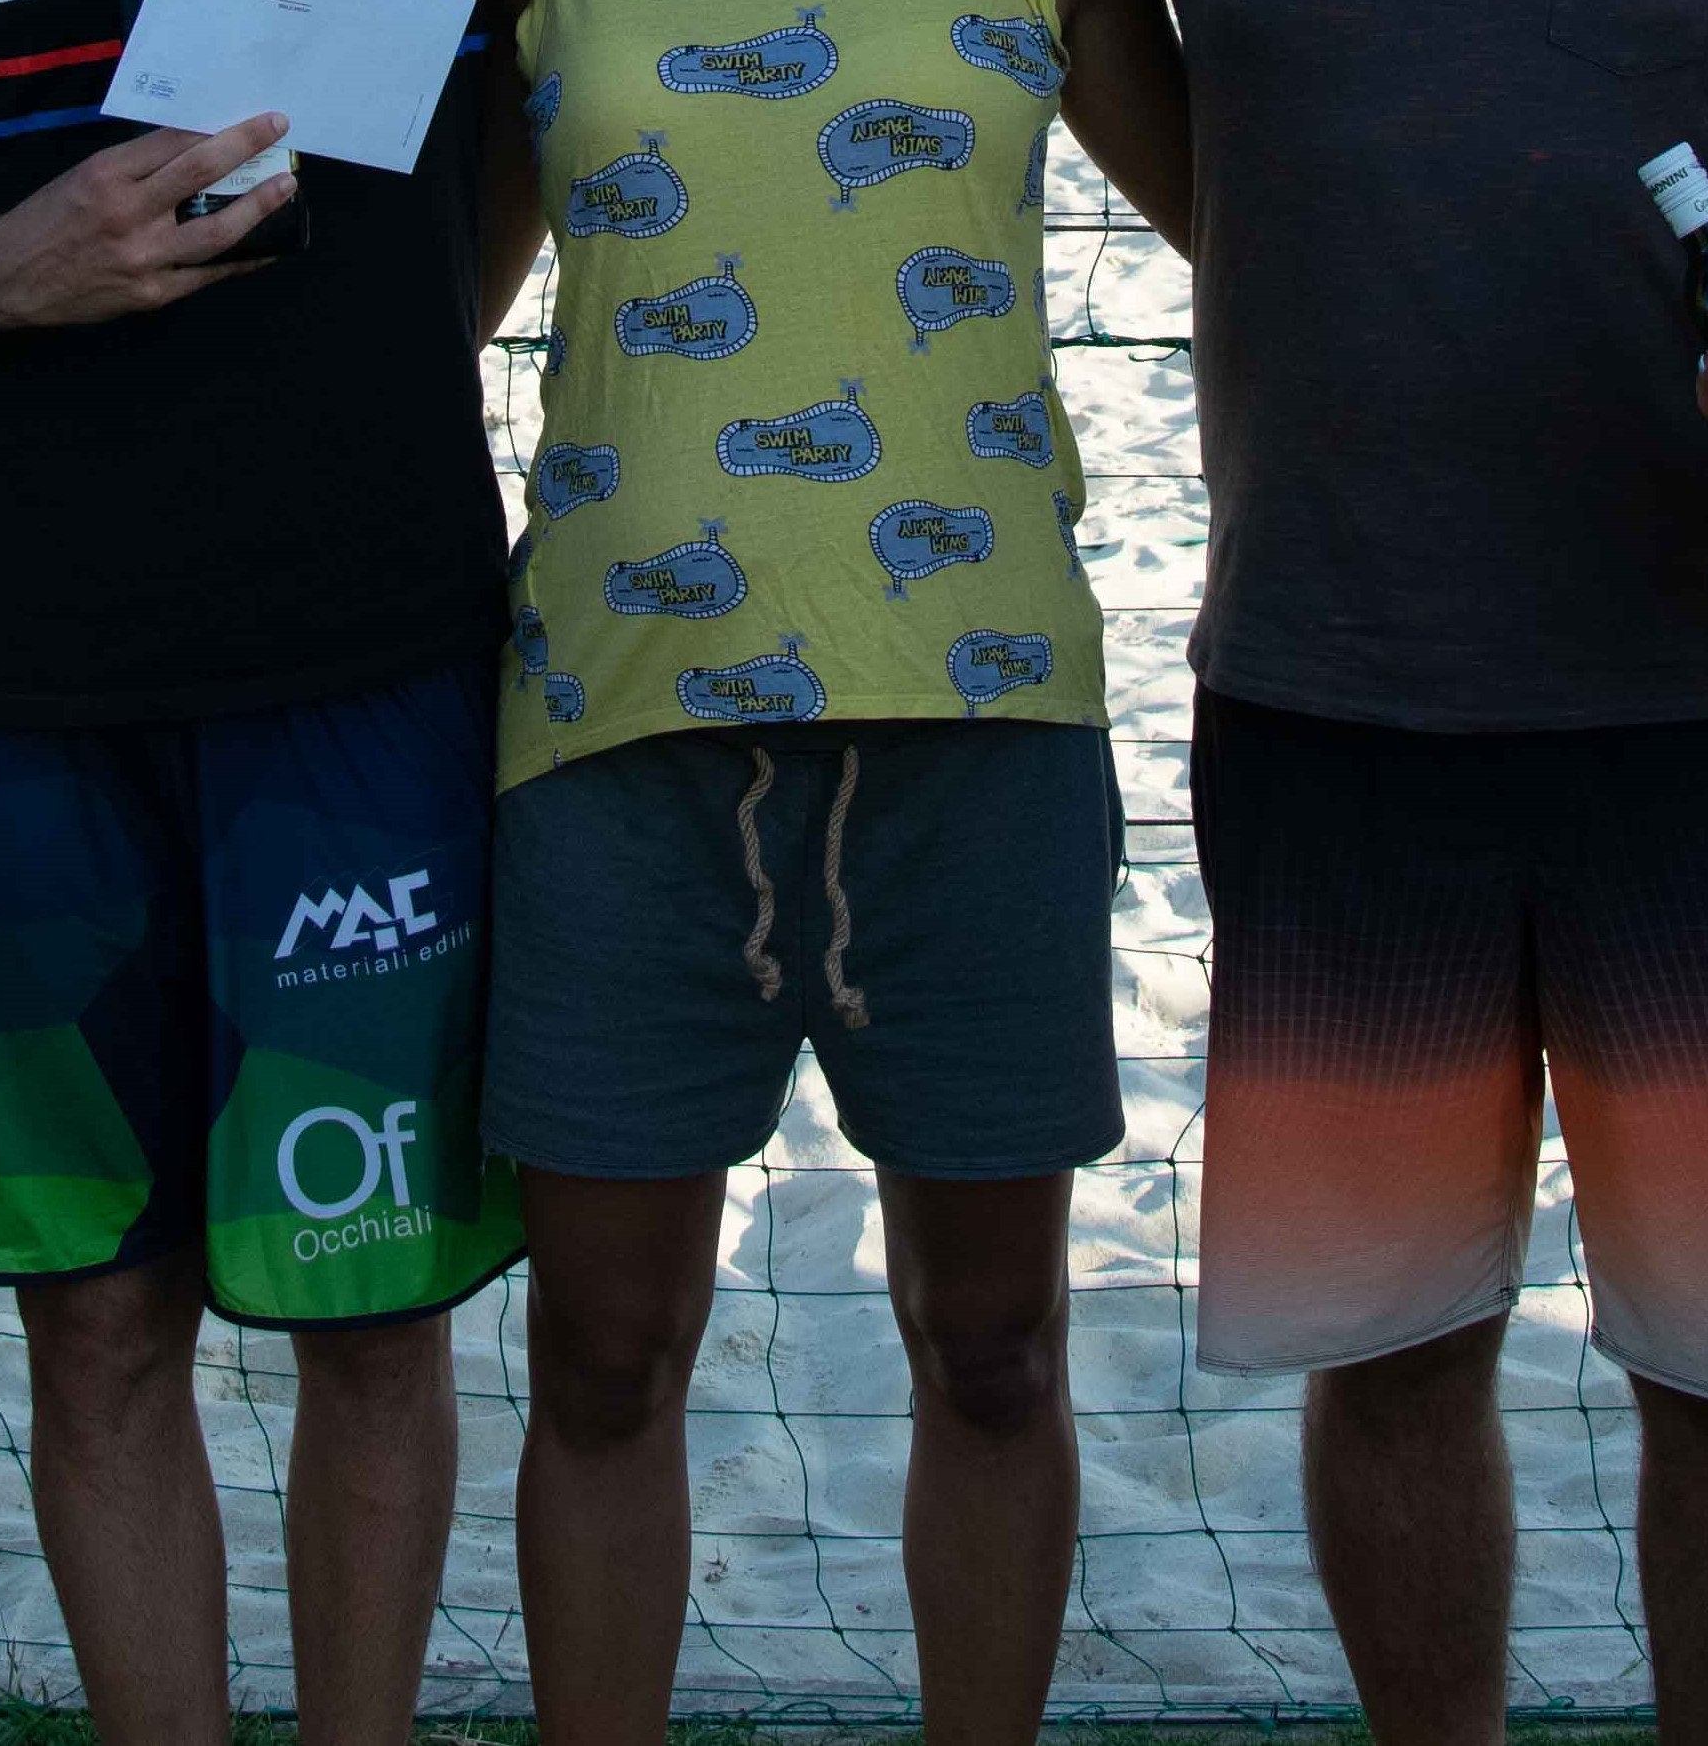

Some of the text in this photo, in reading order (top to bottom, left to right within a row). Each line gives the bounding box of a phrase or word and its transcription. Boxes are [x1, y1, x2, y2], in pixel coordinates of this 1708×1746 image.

[982, 29, 1019, 54] SWIM
[700, 51, 763, 70] SWIM
[737, 62, 805, 85] PARTY
[850, 115, 914, 144] PARTY
[890, 135, 944, 156] SWIM
[605, 196, 658, 223] PARTY
[923, 266, 973, 287] PARTY
[643, 304, 690, 329] SWIM
[670, 320, 728, 344] PARTY
[754, 427, 812, 449] SWIM
[790, 444, 851, 466] PARTY
[898, 519, 947, 539] PARTY
[930, 534, 970, 555] SWIM
[629, 568, 676, 590] SWIM
[657, 582, 716, 605] PARTY
[709, 677, 756, 697] SWIM
[735, 694, 796, 714] PARTY
[274, 868, 438, 960] MAC
[276, 921, 472, 989] materiali edili
[277, 1100, 417, 1220] Of
[294, 1205, 432, 1261] Occhiali
